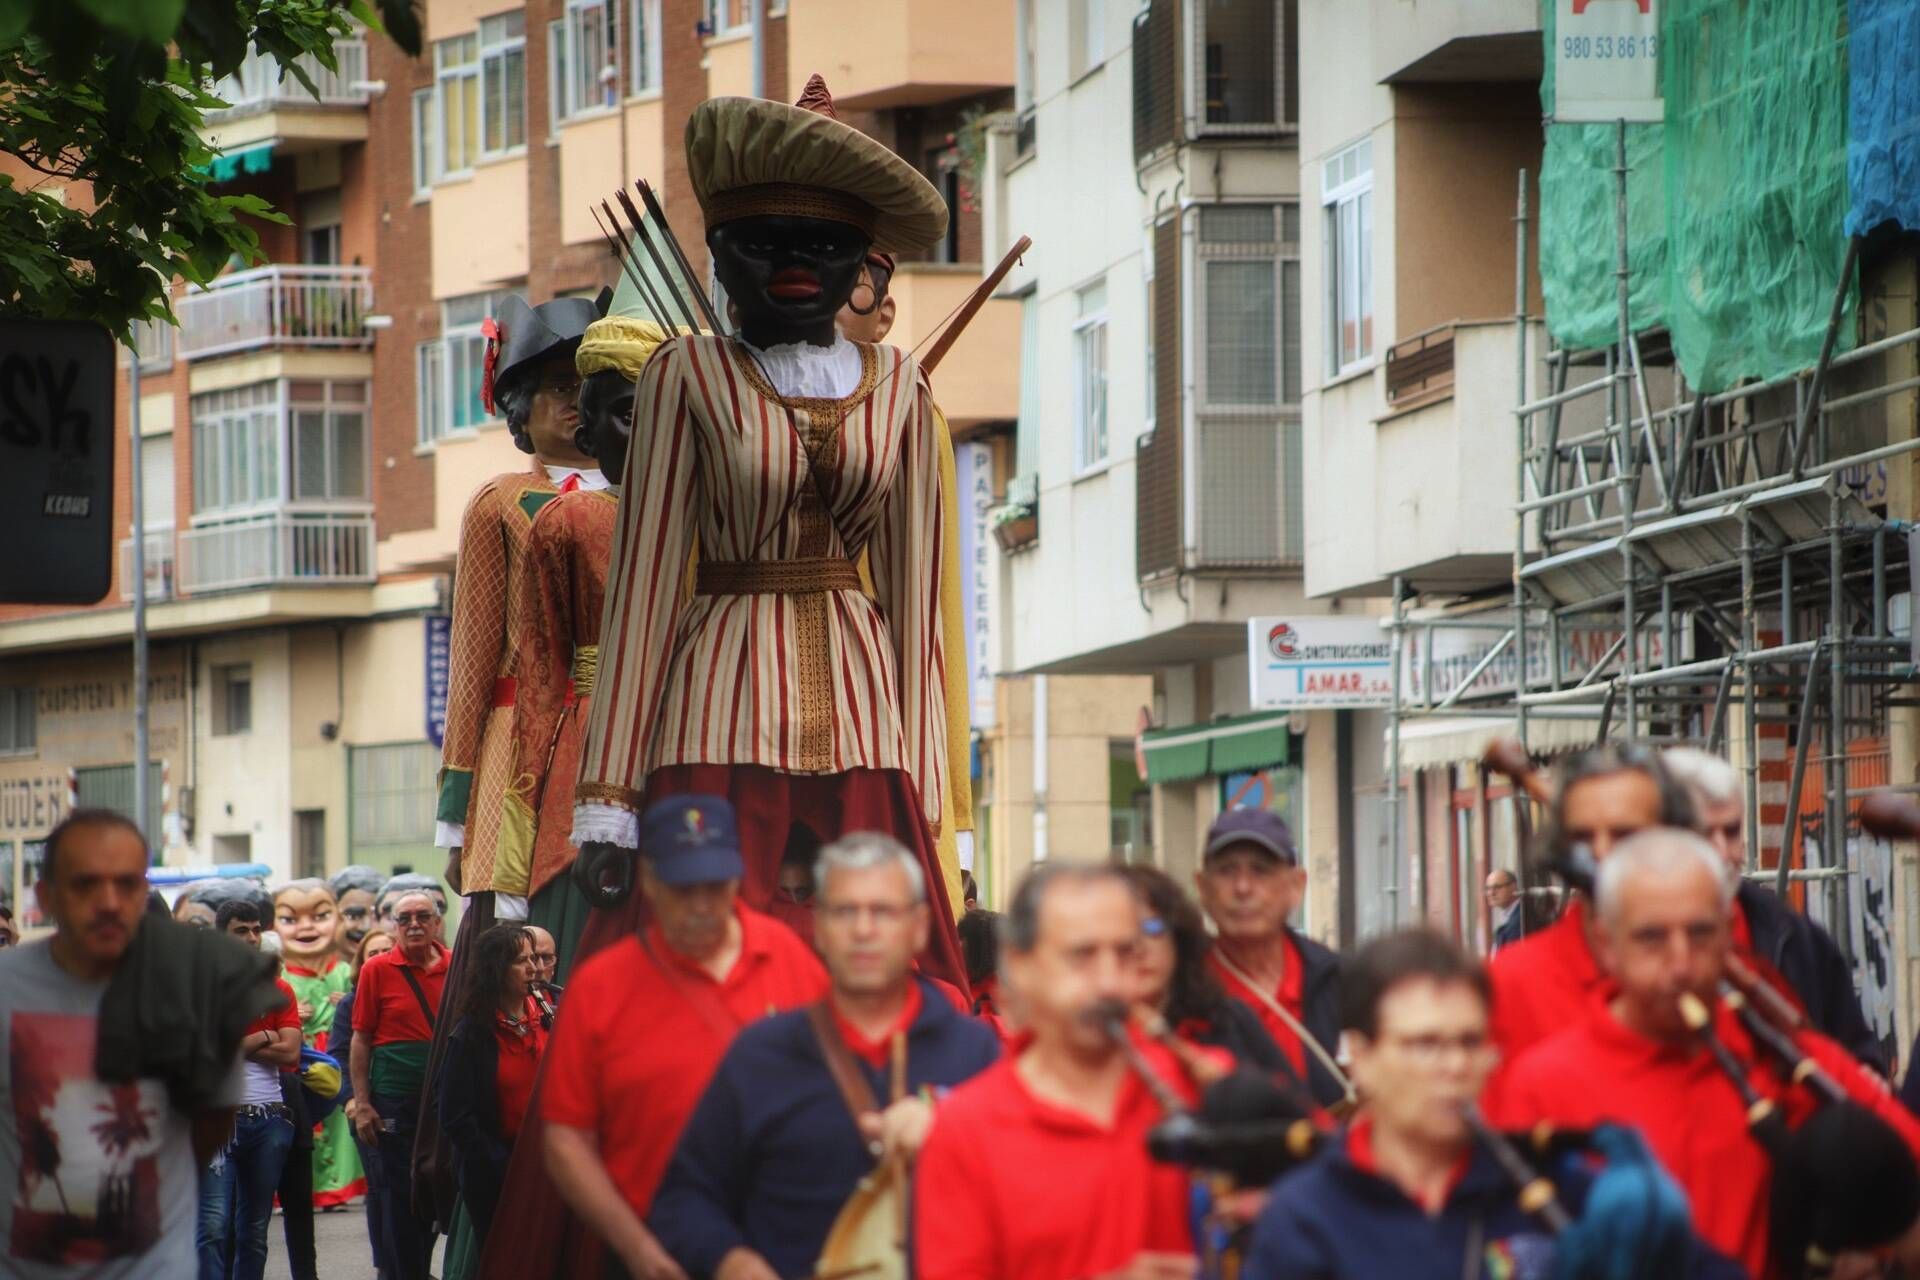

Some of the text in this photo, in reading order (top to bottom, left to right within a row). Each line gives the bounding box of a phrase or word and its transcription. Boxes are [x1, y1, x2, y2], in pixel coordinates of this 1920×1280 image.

[1564, 35, 1657, 58] 980 53 86 13
[974, 453, 991, 680] PASTELERIA
[1268, 623, 1391, 660] CONSTRUCCIONES
